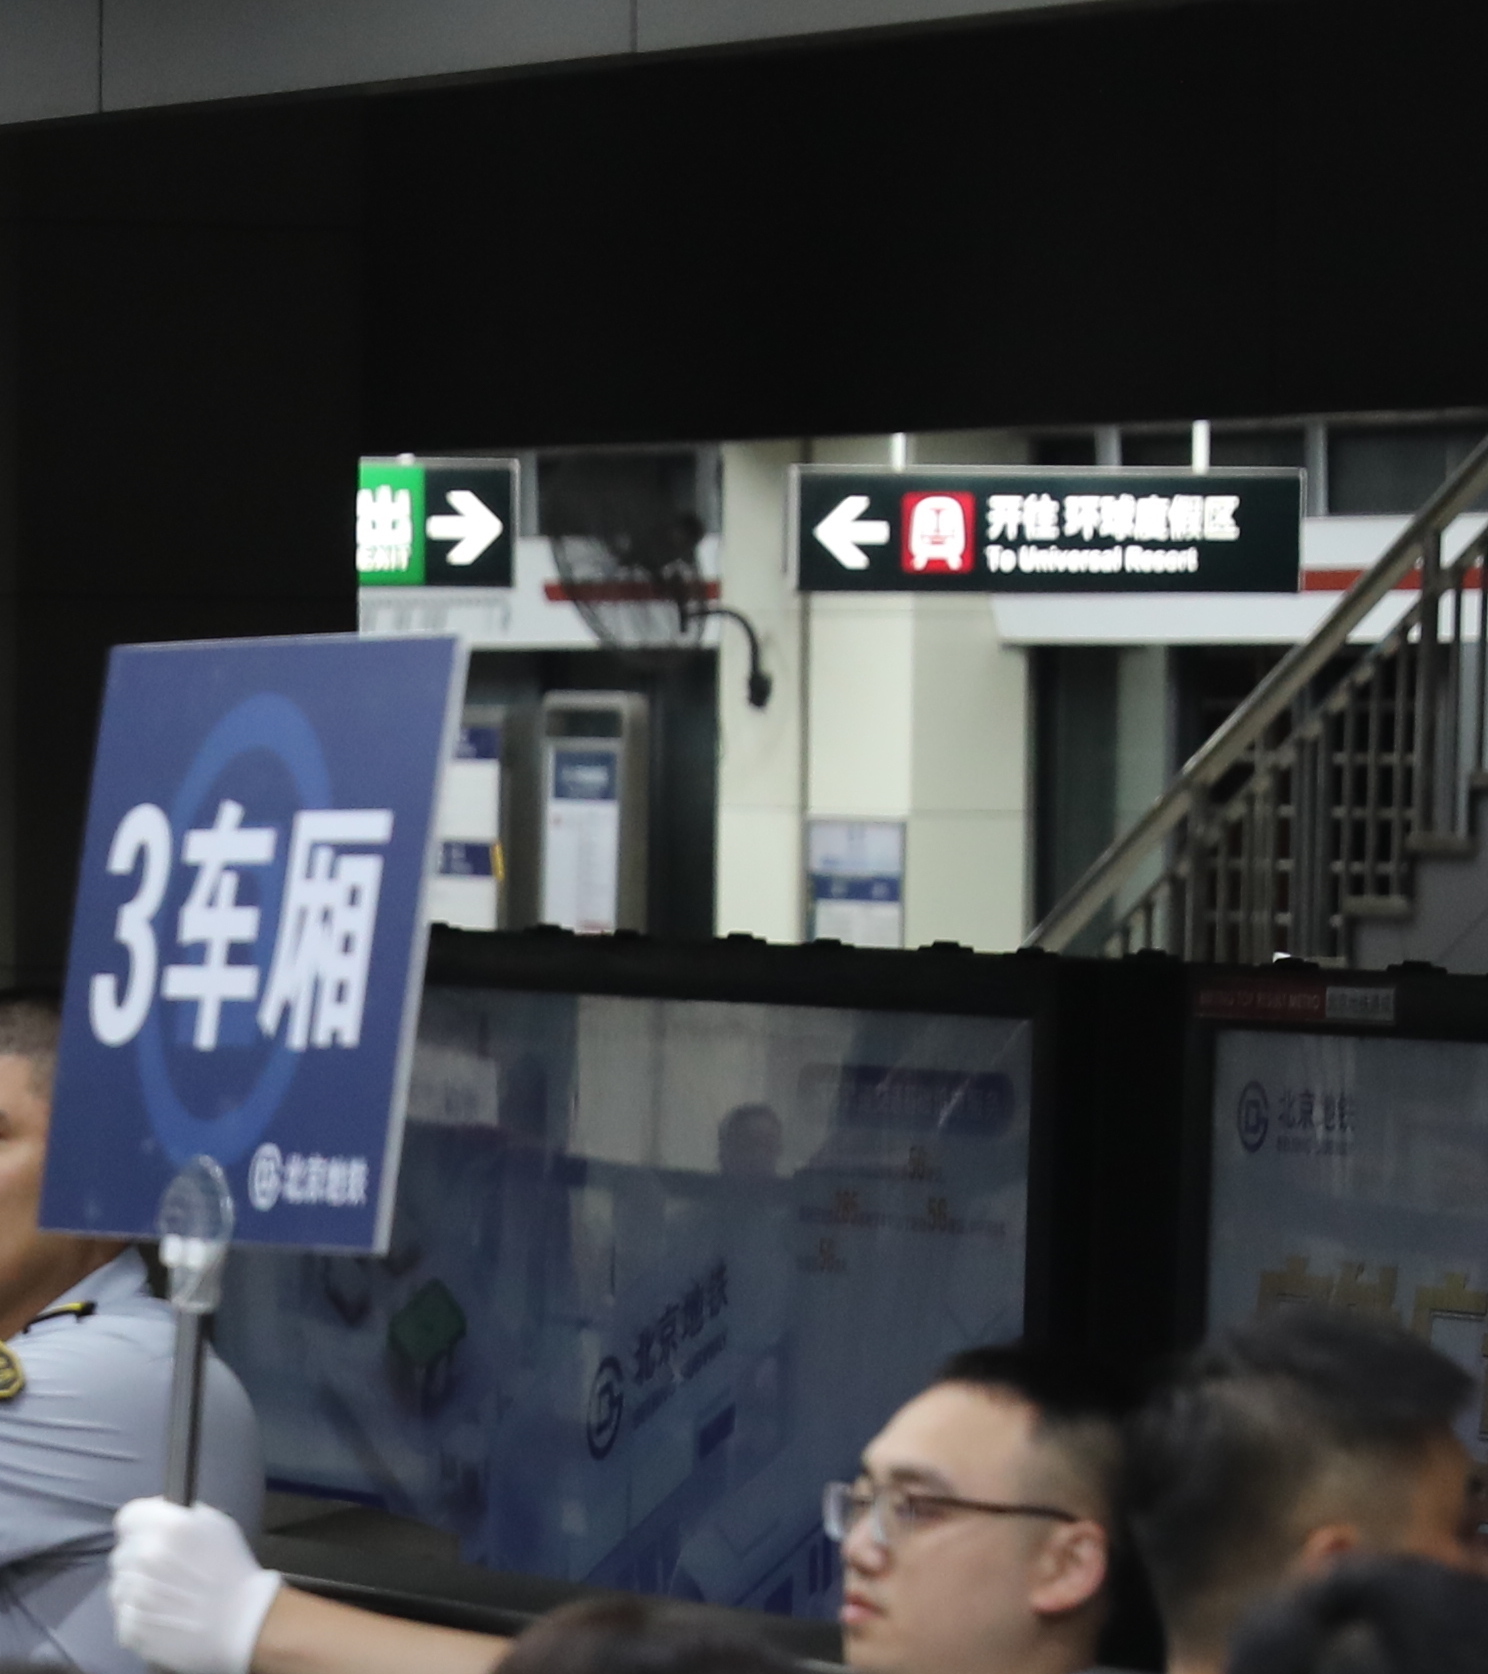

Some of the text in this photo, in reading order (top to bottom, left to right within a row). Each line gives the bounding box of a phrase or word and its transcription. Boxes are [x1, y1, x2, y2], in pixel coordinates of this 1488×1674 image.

[357, 485, 412, 545] 出
[986, 493, 1240, 541] 开往 环球度假区
[356, 544, 411, 572] EXIT
[985, 544, 1199, 573] To Universal Resort
[89, 799, 394, 1052] 3车厢
[282, 1152, 369, 1206] 北京地铁
[632, 1257, 729, 1386] 北京地铁
